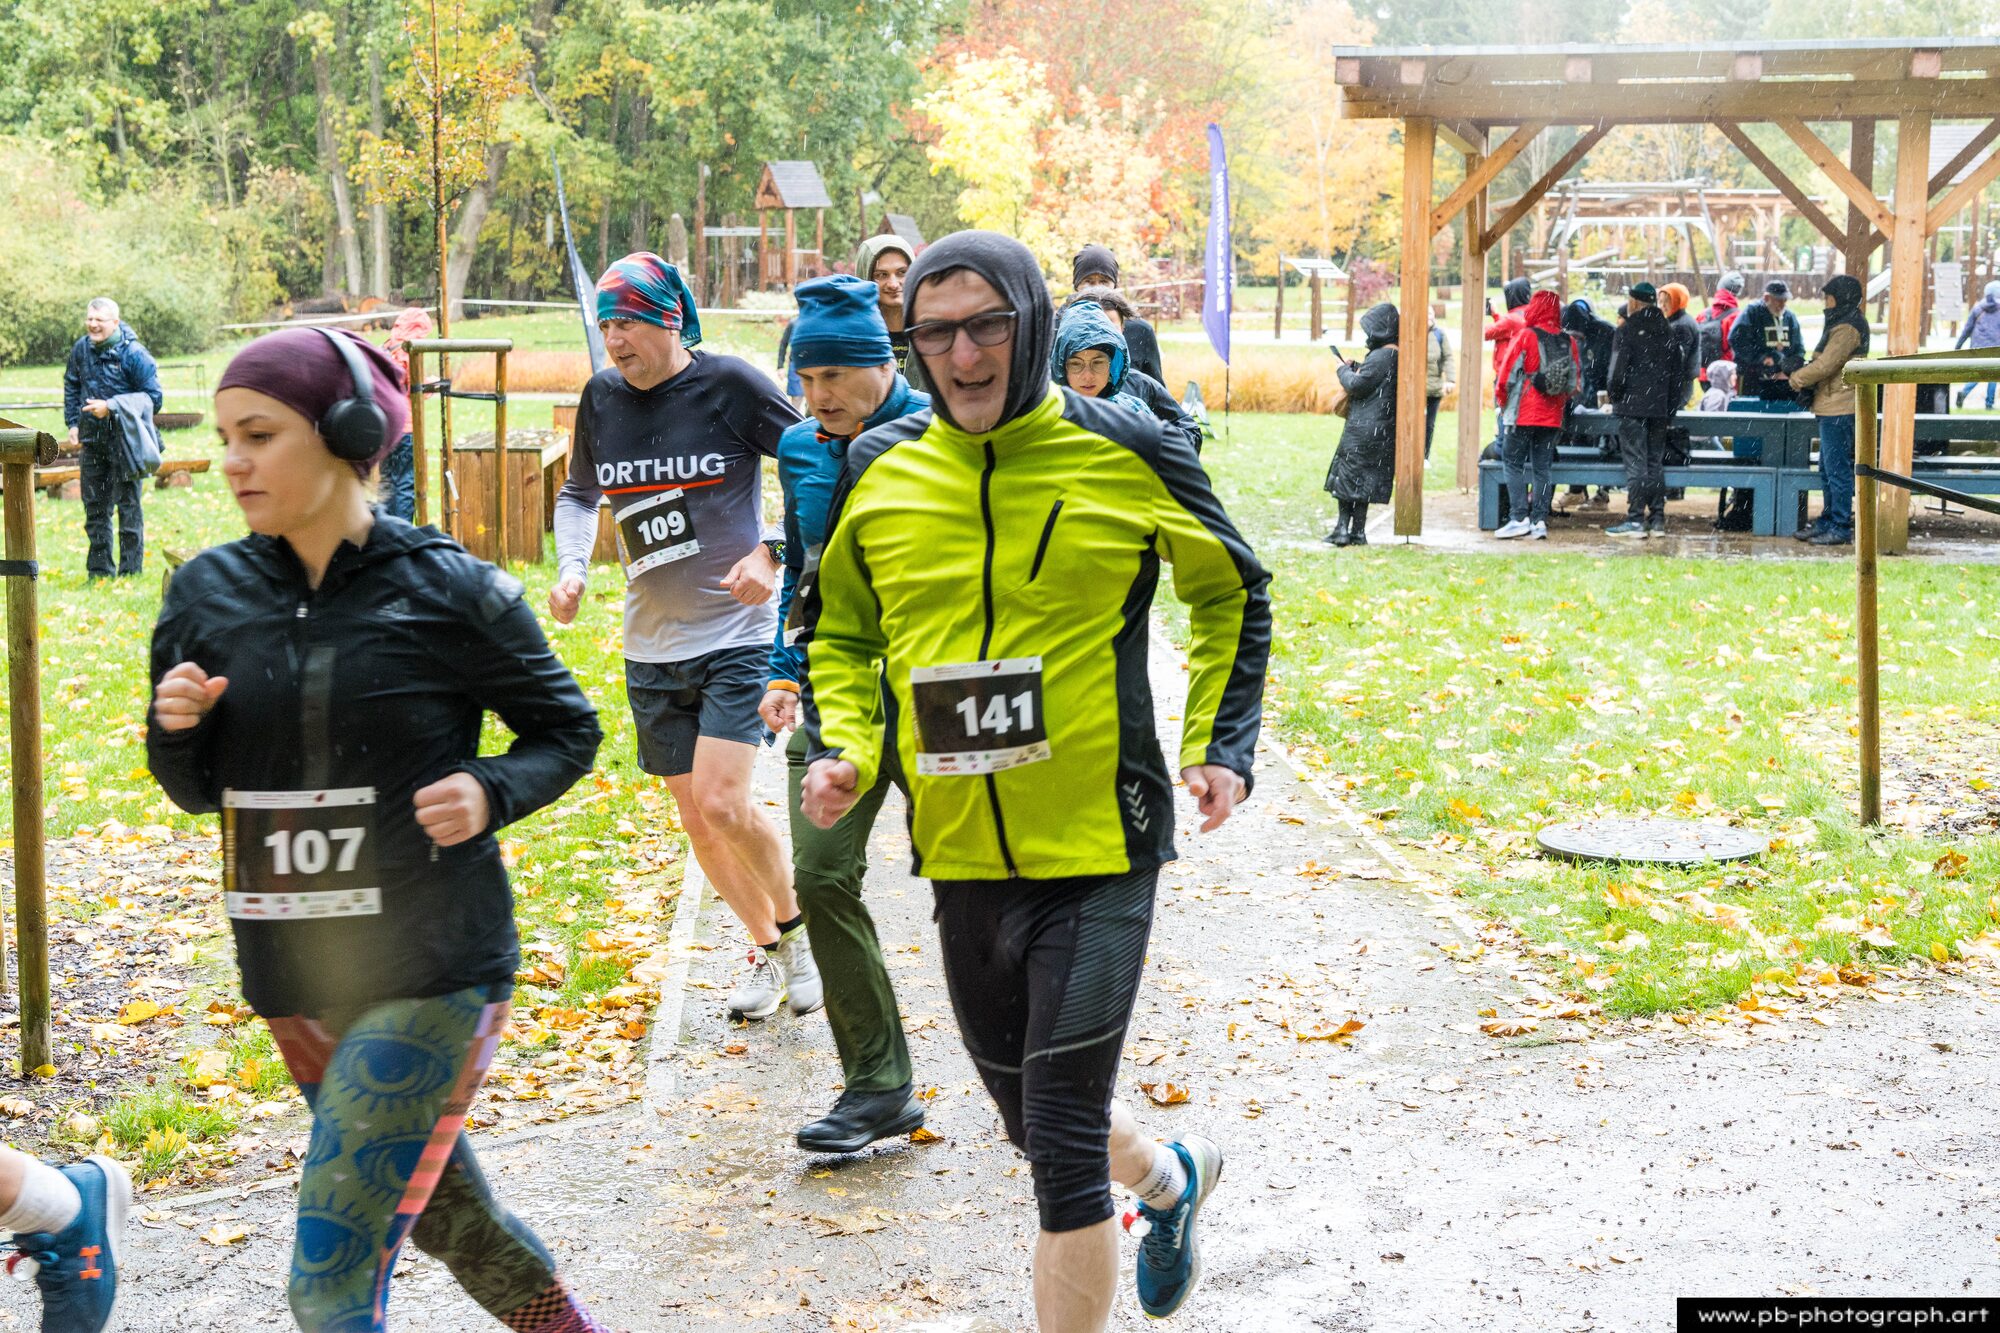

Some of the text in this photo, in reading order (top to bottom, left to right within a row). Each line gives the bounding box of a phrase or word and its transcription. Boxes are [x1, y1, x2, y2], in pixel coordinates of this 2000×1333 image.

[638, 510, 686, 545] 109
[956, 691, 1034, 737] 141
[264, 827, 366, 875] 107
